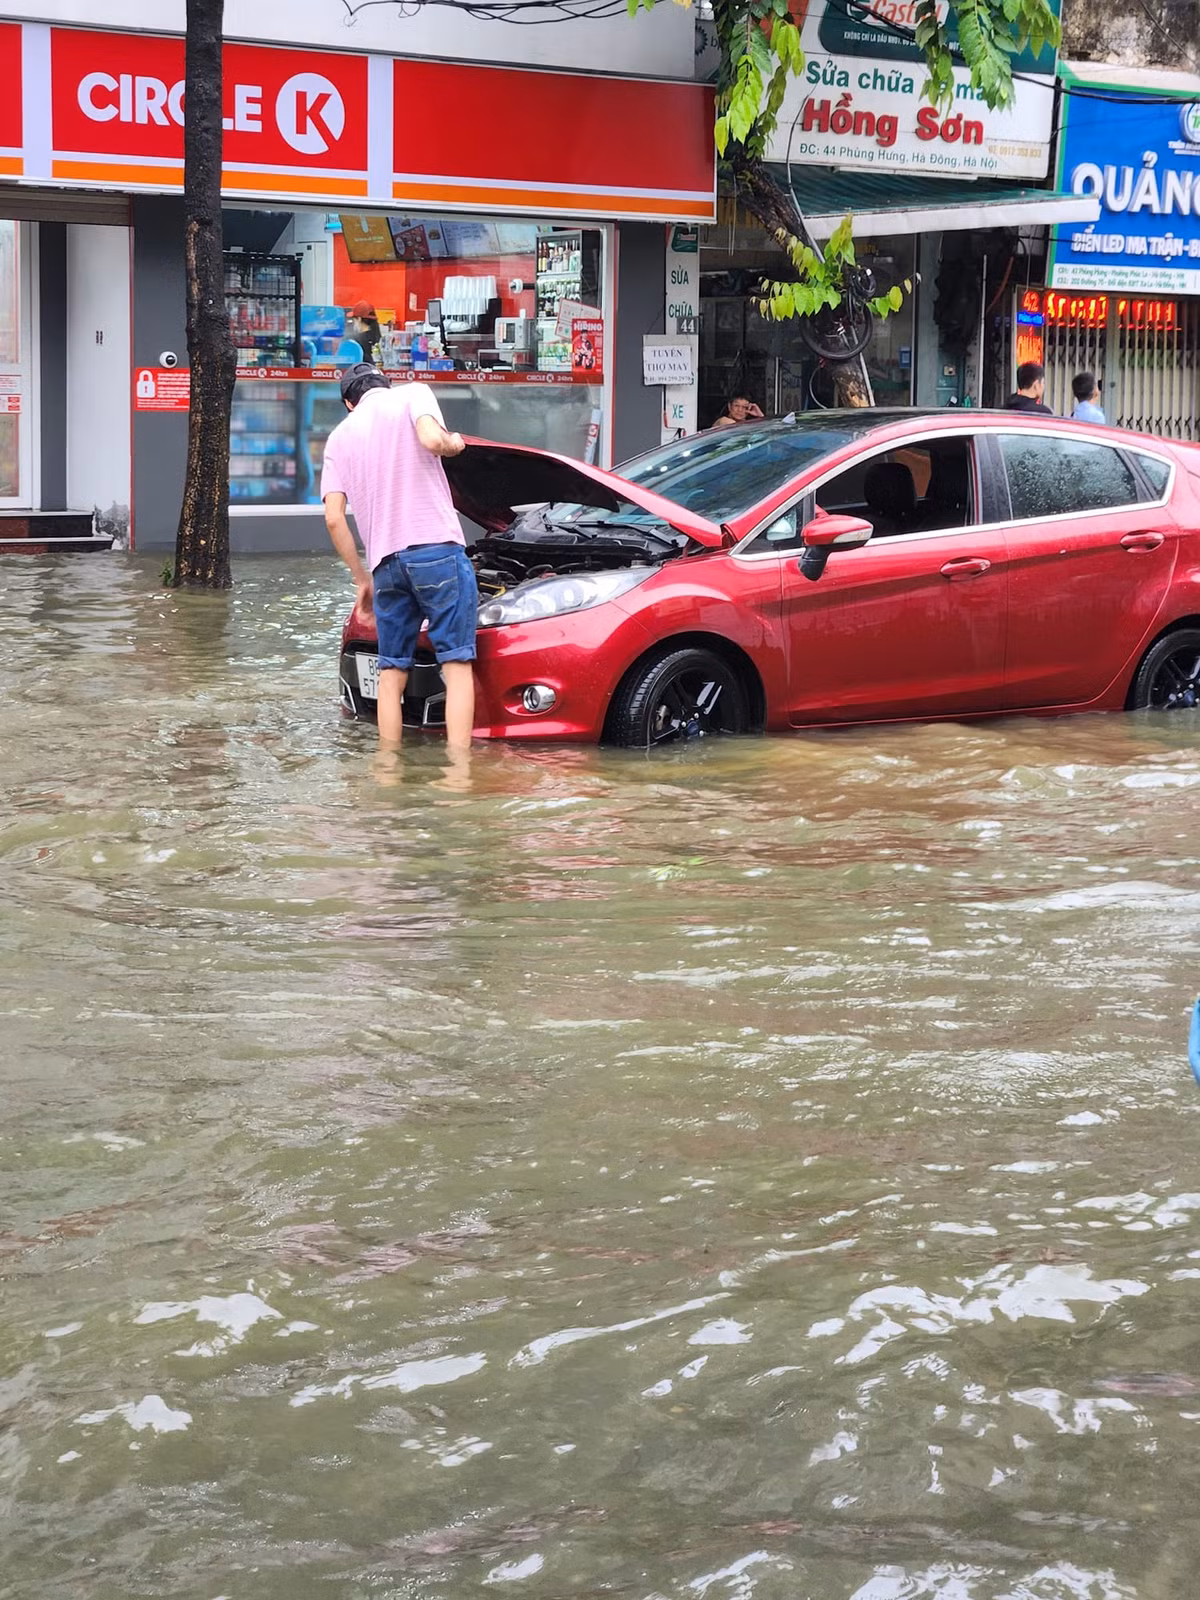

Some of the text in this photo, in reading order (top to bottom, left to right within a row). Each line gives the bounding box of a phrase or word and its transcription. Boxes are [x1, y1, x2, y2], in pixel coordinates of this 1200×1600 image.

[806, 59, 849, 87] Sửa
[858, 68, 914, 94] chữa
[77, 72, 262, 133] CIRE
[802, 92, 984, 147] Hồng Sơn
[800, 142, 998, 170] ĐC: 44 Phùng Hưng, Hà Đông, Hà Nội
[1102, 234, 1125, 254] LED
[1125, 236, 1148, 255] MA
[1148, 232, 1184, 262] TRẬN
[670, 264, 690, 284] SỬA
[668, 300, 693, 318] CHỮA
[680, 319, 695, 332] 44
[672, 404, 684, 418] XE
[364, 677, 380, 697] 57
